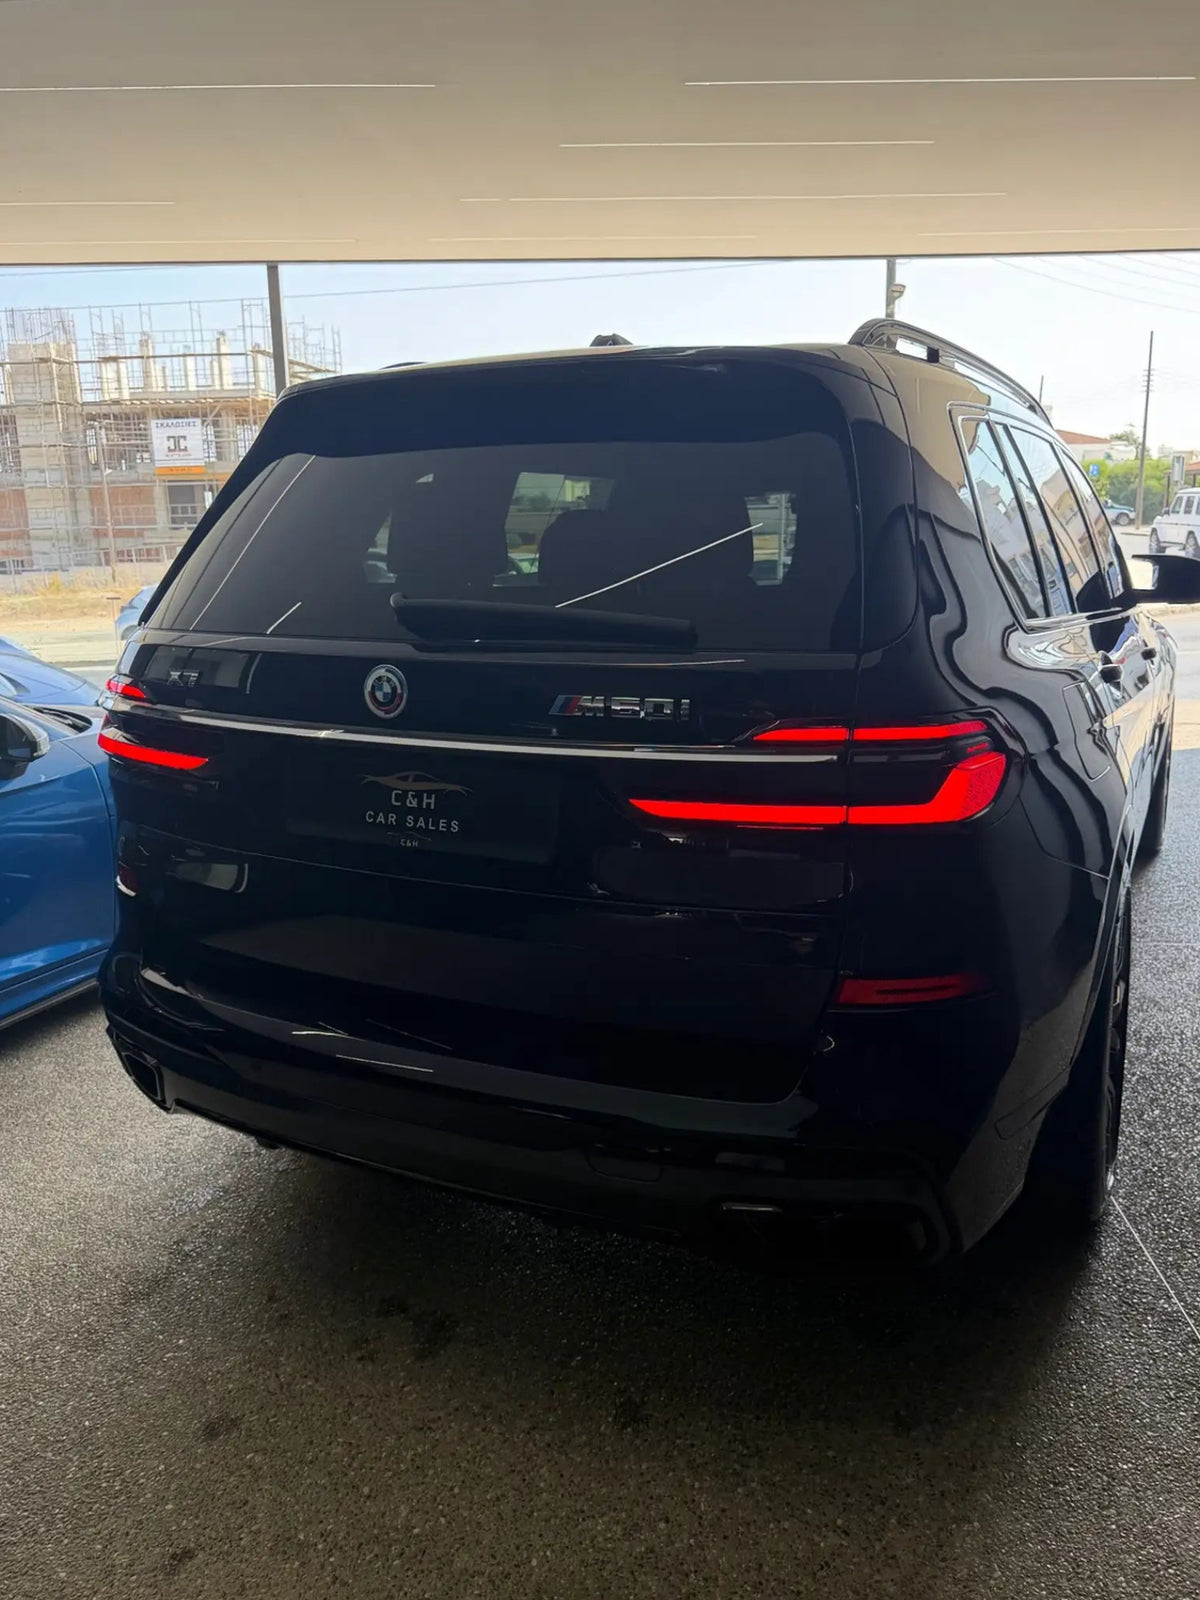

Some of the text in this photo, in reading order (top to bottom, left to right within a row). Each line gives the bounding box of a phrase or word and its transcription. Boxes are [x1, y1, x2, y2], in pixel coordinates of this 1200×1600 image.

[166, 669, 200, 687] X7
[391, 790, 436, 810] C&H
[365, 810, 460, 833] CAR SALES
[400, 838, 418, 848] C&H
